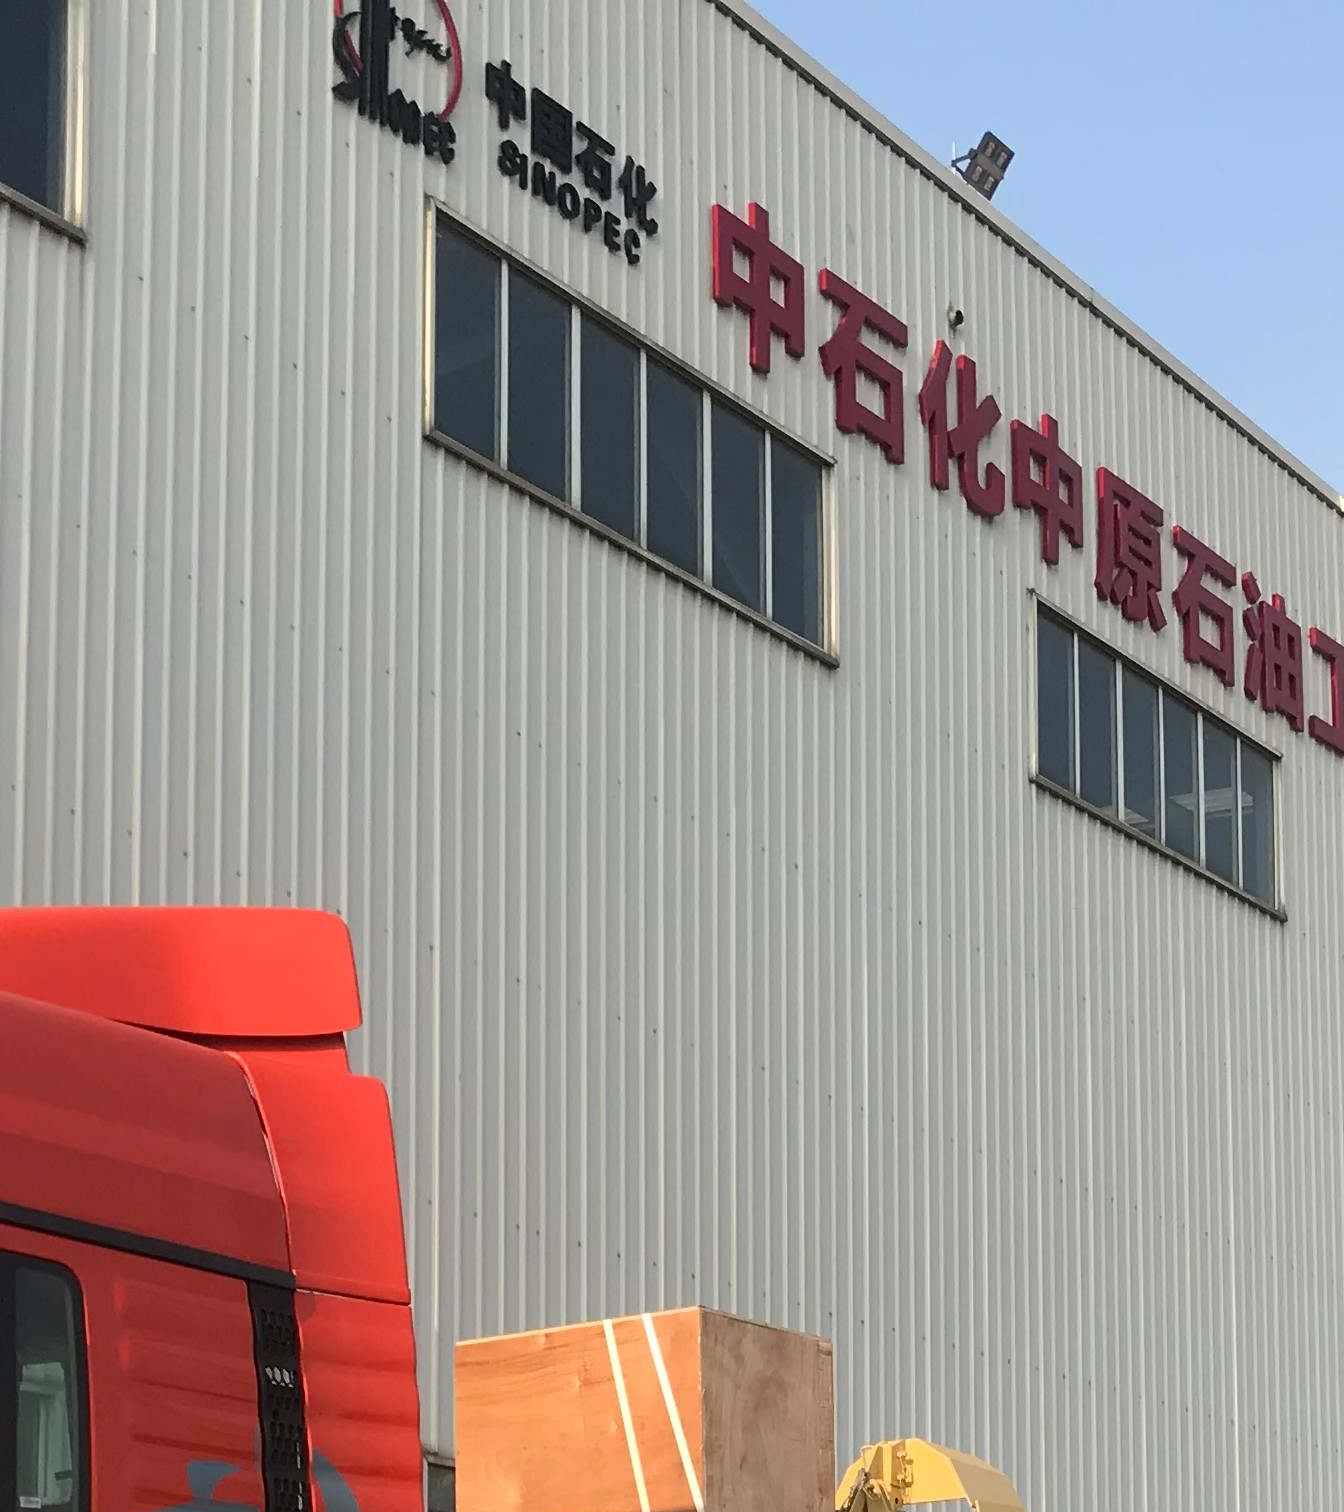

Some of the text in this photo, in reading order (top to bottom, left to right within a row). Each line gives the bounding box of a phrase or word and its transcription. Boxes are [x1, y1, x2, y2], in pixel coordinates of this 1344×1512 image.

[485, 60, 658, 236] 中国石化
[498, 140, 641, 265] SINOPEC
